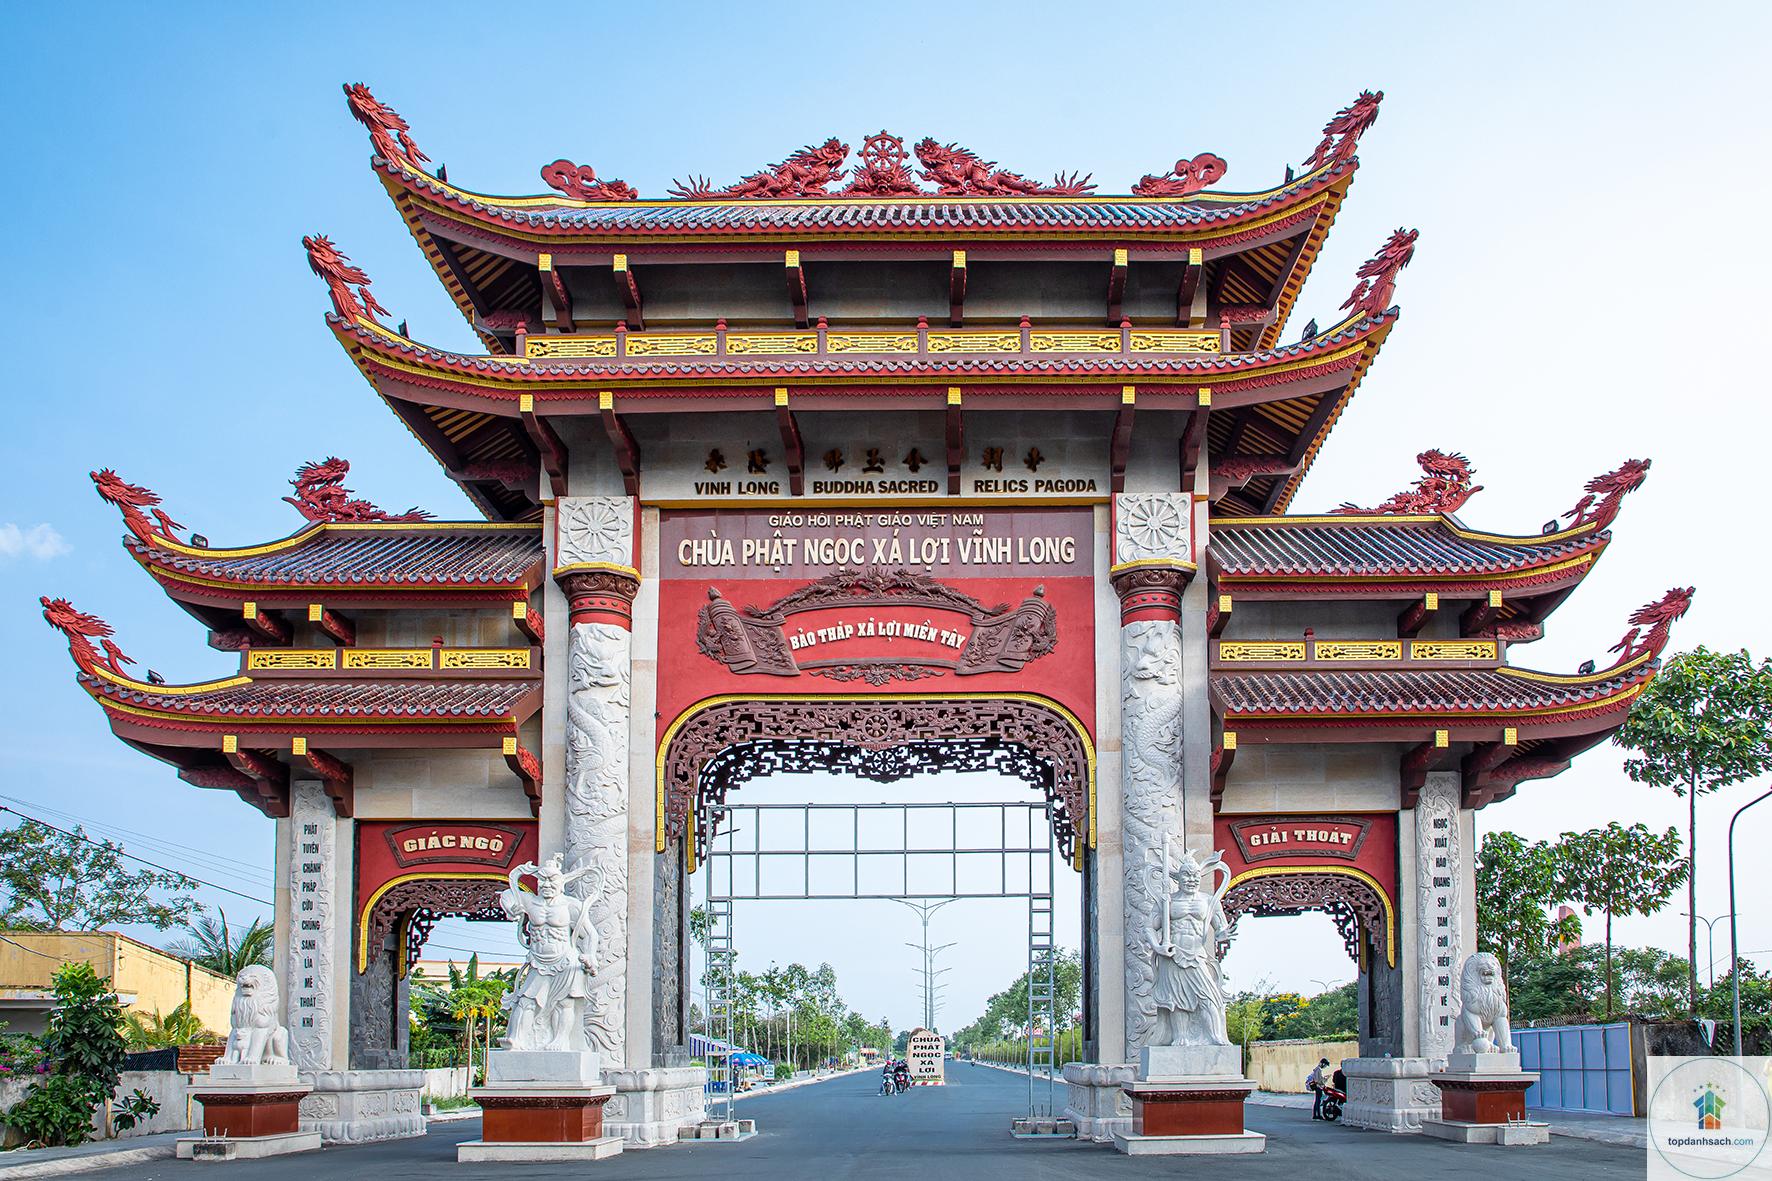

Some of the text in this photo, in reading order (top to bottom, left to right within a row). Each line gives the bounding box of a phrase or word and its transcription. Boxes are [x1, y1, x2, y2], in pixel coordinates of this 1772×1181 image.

[694, 479, 1097, 495] VINH LONG BUDDHA SACRED RELICS PAGODA
[768, 511, 804, 527] GIÁO
[835, 512, 873, 528] PHẬT
[877, 511, 913, 526] GIÁO
[917, 512, 947, 528] VIỆT
[952, 513, 985, 526] NAM
[678, 528, 1076, 571] CHÙA PHẬT NGỌC XÁ LỢI VĨNH LONG
[789, 627, 817, 651] BẢO
[878, 620, 901, 642] LỢI
[903, 619, 938, 643] MIỀN
[940, 628, 967, 650] TÂY
[403, 831, 505, 856] GIÁC NGỘ
[1250, 826, 1353, 846] GIẢI THOÁT
[1432, 876, 1451, 889] QUANG
[1437, 916, 1448, 928] TAM
[301, 939, 316, 950] SANH
